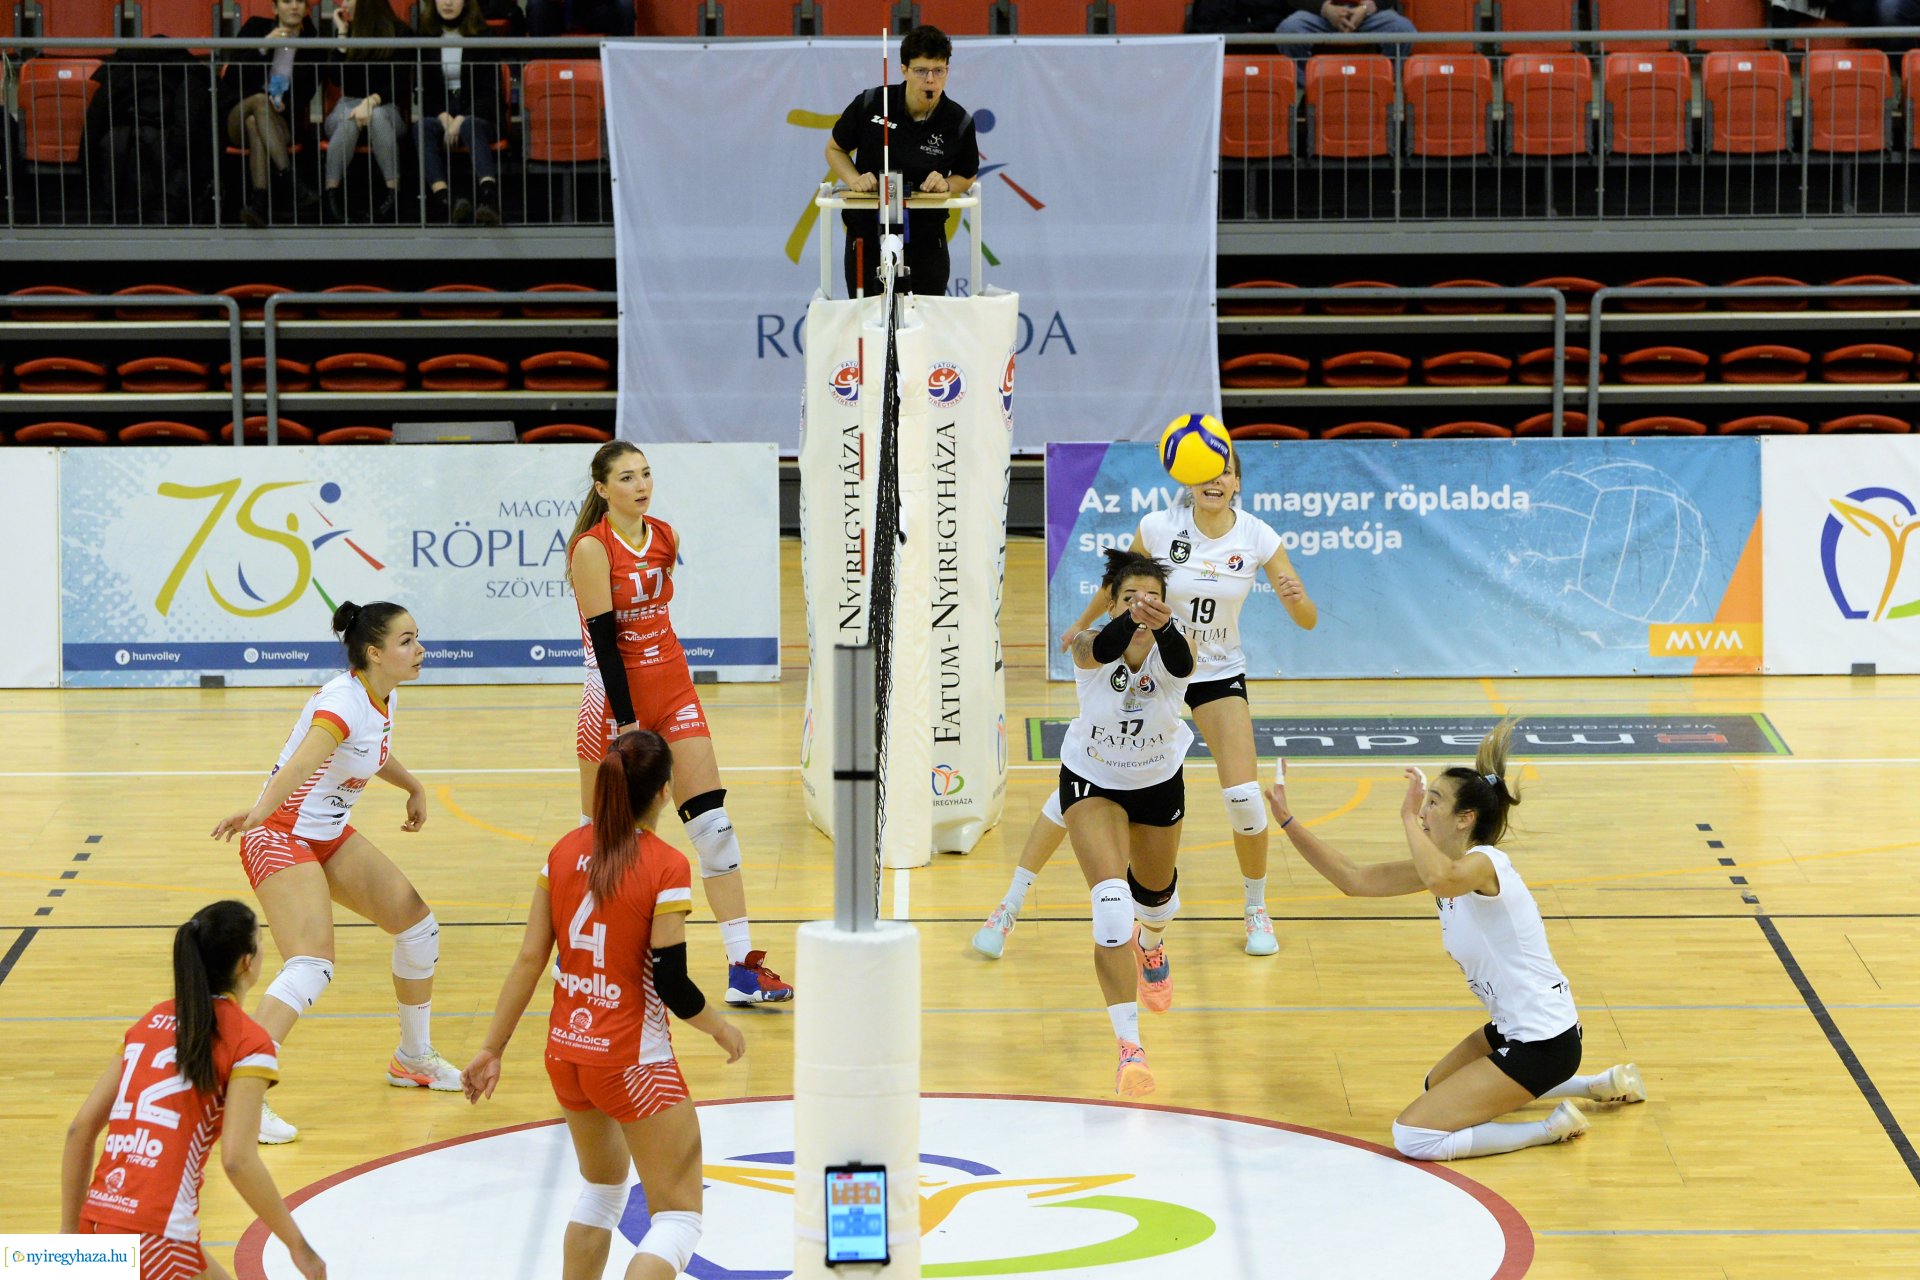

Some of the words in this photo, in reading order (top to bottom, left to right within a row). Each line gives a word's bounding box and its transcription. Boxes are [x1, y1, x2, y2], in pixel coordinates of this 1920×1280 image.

[841, 361, 858, 370] FATU
[498, 500, 583, 518] MAGYA
[1078, 486, 1121, 513] Az
[1131, 486, 1185, 513] MV
[1253, 491, 1375, 518] magyar
[1385, 483, 1531, 517] röplabda
[412, 521, 568, 568] RÖPLA
[1079, 532, 1135, 558] spo
[1281, 520, 1403, 556] ogatója
[628, 566, 663, 604] 17
[1190, 597, 1216, 625] 19
[1664, 629, 1743, 650] MVM
[132, 650, 181, 663] hunvolley
[261, 648, 310, 663] hunvolley
[423, 649, 474, 661] nvolley.hu
[547, 648, 585, 659] hunvoll
[684, 646, 715, 659] volley
[670, 721, 706, 733] SEAT
[1091, 723, 1165, 749] FATUM
[1119, 718, 1145, 737] 17
[378, 735, 389, 767] 6
[932, 797, 973, 807] ÍREGYHÁZA
[569, 890, 607, 969] 4
[557, 972, 622, 1000] apollo
[586, 995, 620, 1009] TYRES
[148, 1013, 177, 1032] SIT
[551, 1027, 610, 1047] SZABADICS
[108, 1042, 194, 1130] 12
[105, 1127, 163, 1160] apollo
